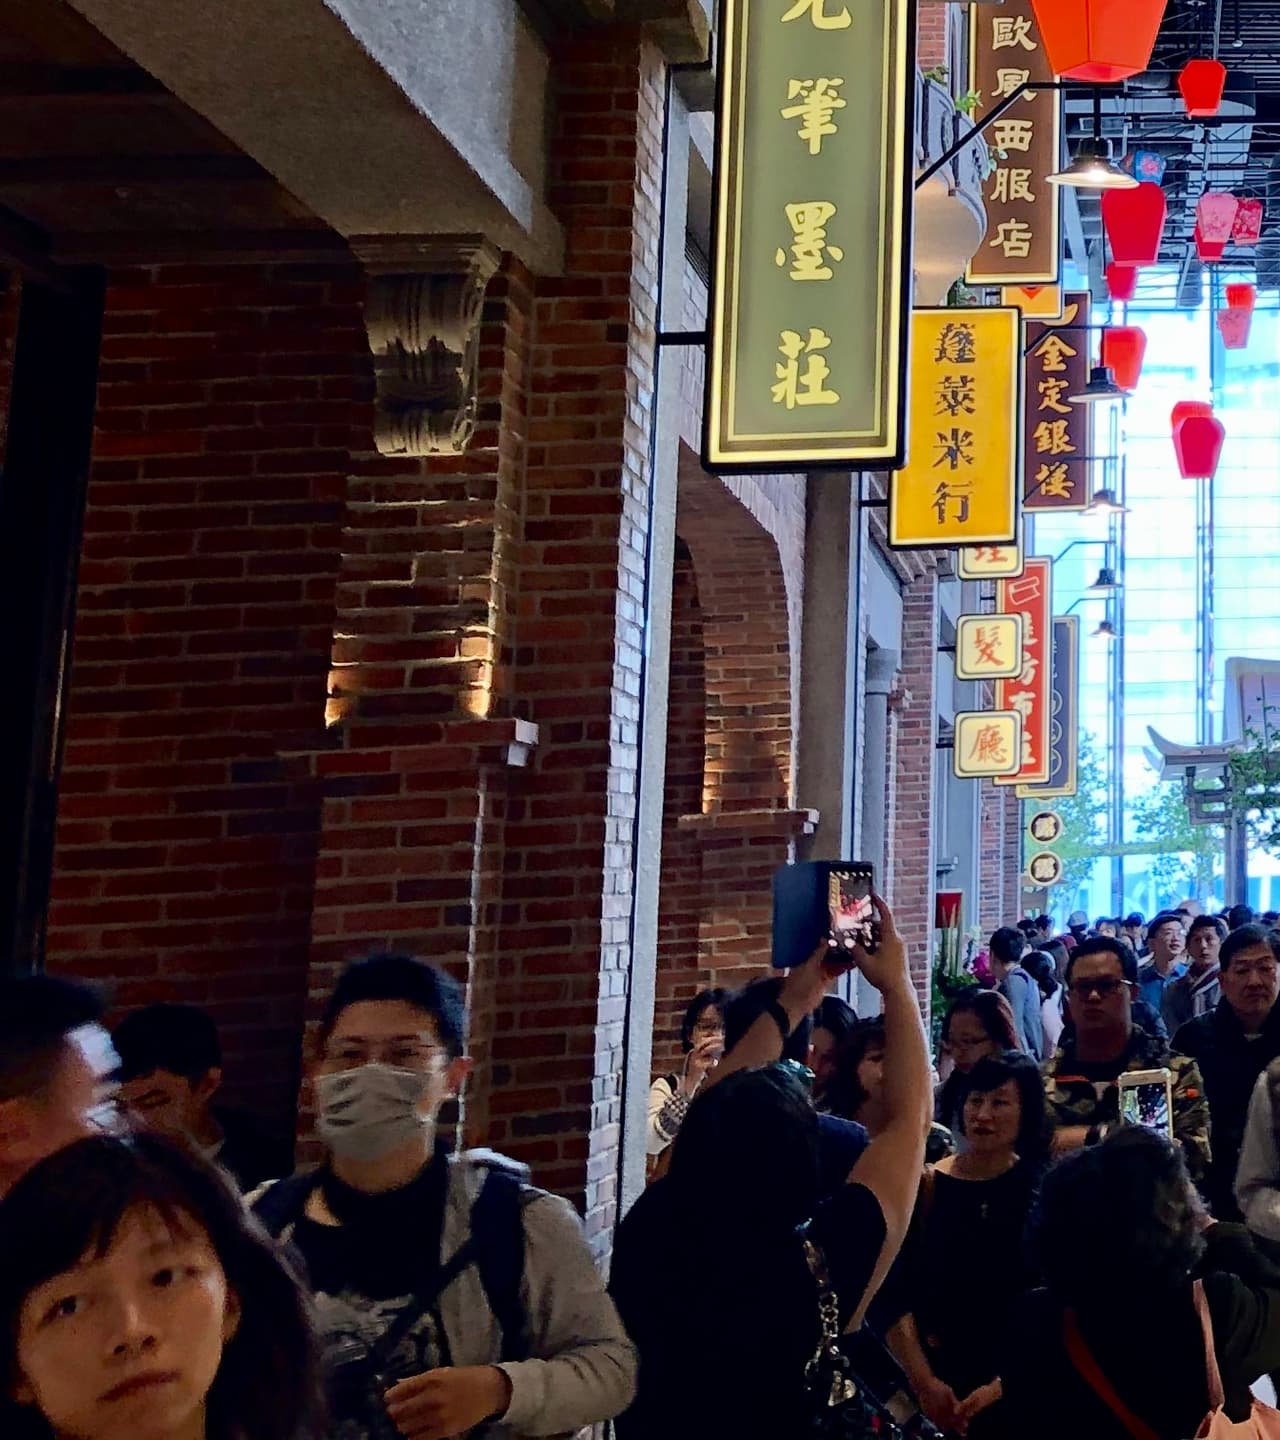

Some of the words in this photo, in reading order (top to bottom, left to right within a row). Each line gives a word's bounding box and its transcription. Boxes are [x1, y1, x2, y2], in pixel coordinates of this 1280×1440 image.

[989, 15, 1037, 259] 歐風西服店
[931, 322, 977, 525] 蓬萊米行
